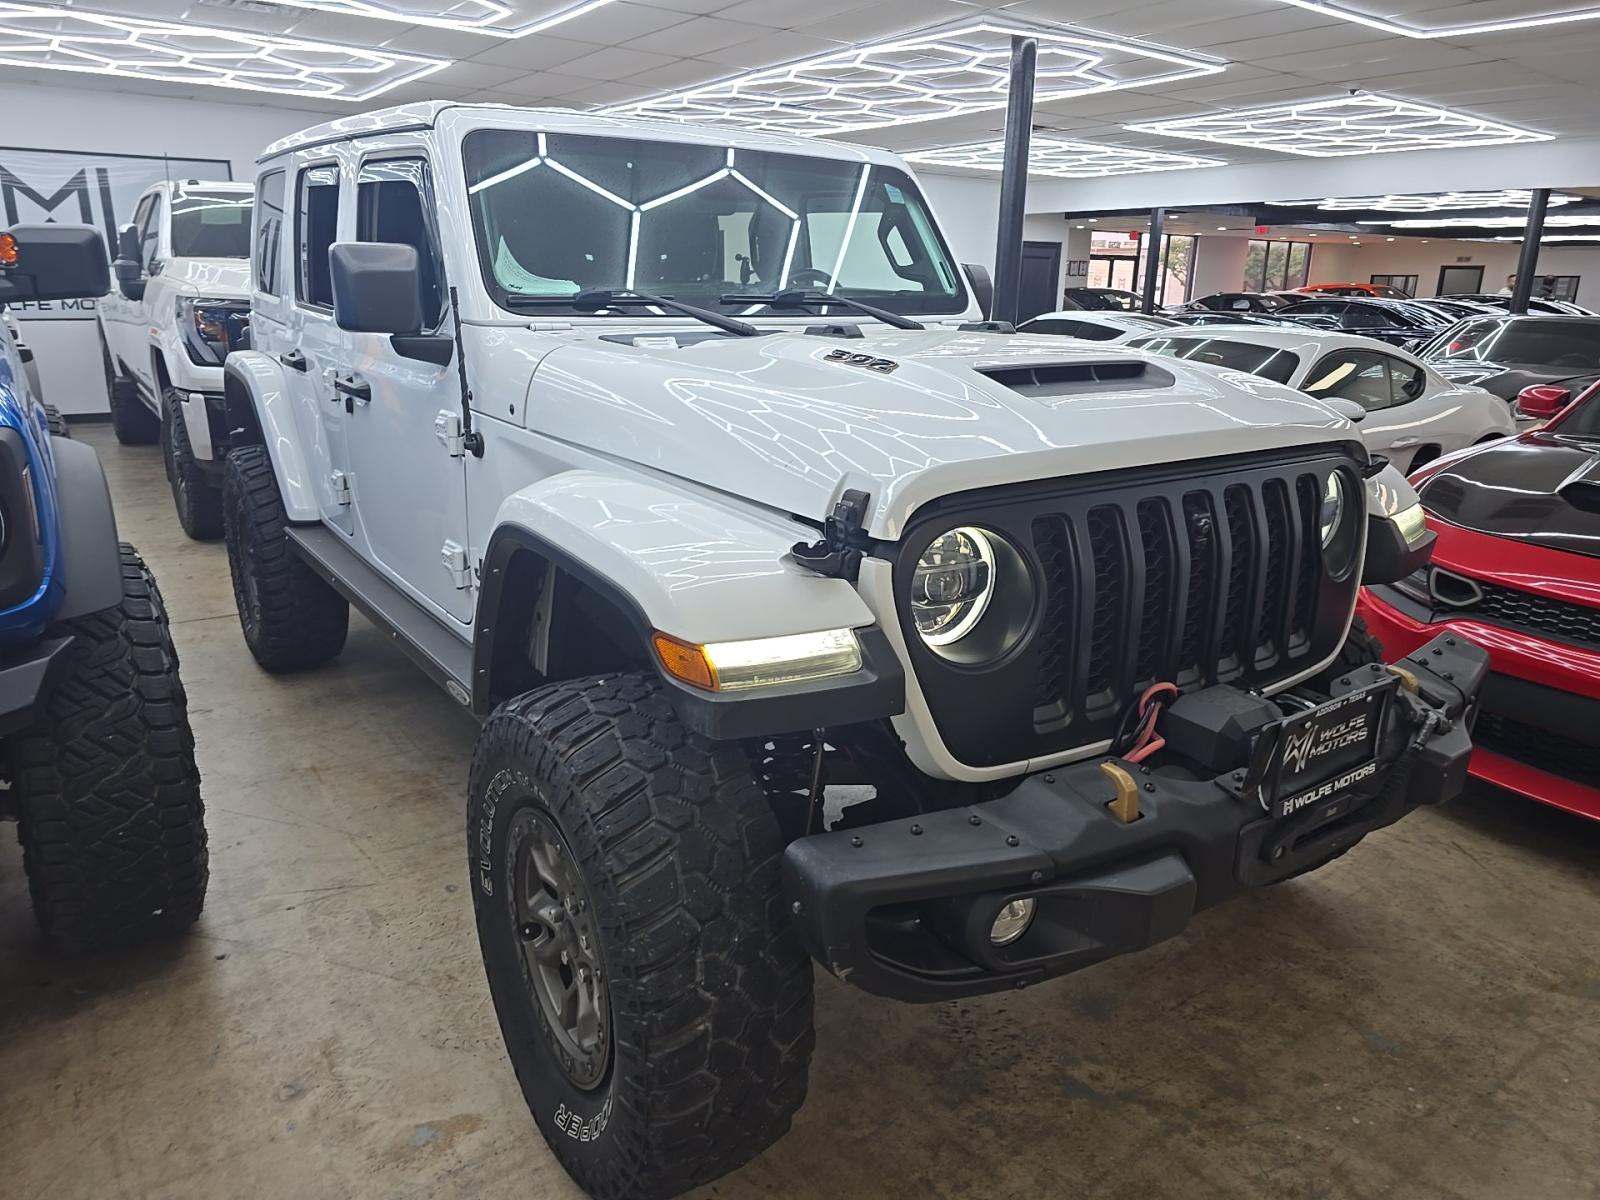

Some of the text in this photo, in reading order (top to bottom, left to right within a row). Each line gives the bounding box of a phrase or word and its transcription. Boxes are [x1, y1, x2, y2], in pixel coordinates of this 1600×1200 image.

[1320, 713, 1367, 742] WOLFE
[1309, 728, 1368, 759] MOTORS
[1295, 783, 1333, 809] WOLFE
[1334, 763, 1376, 791] MOTORS
